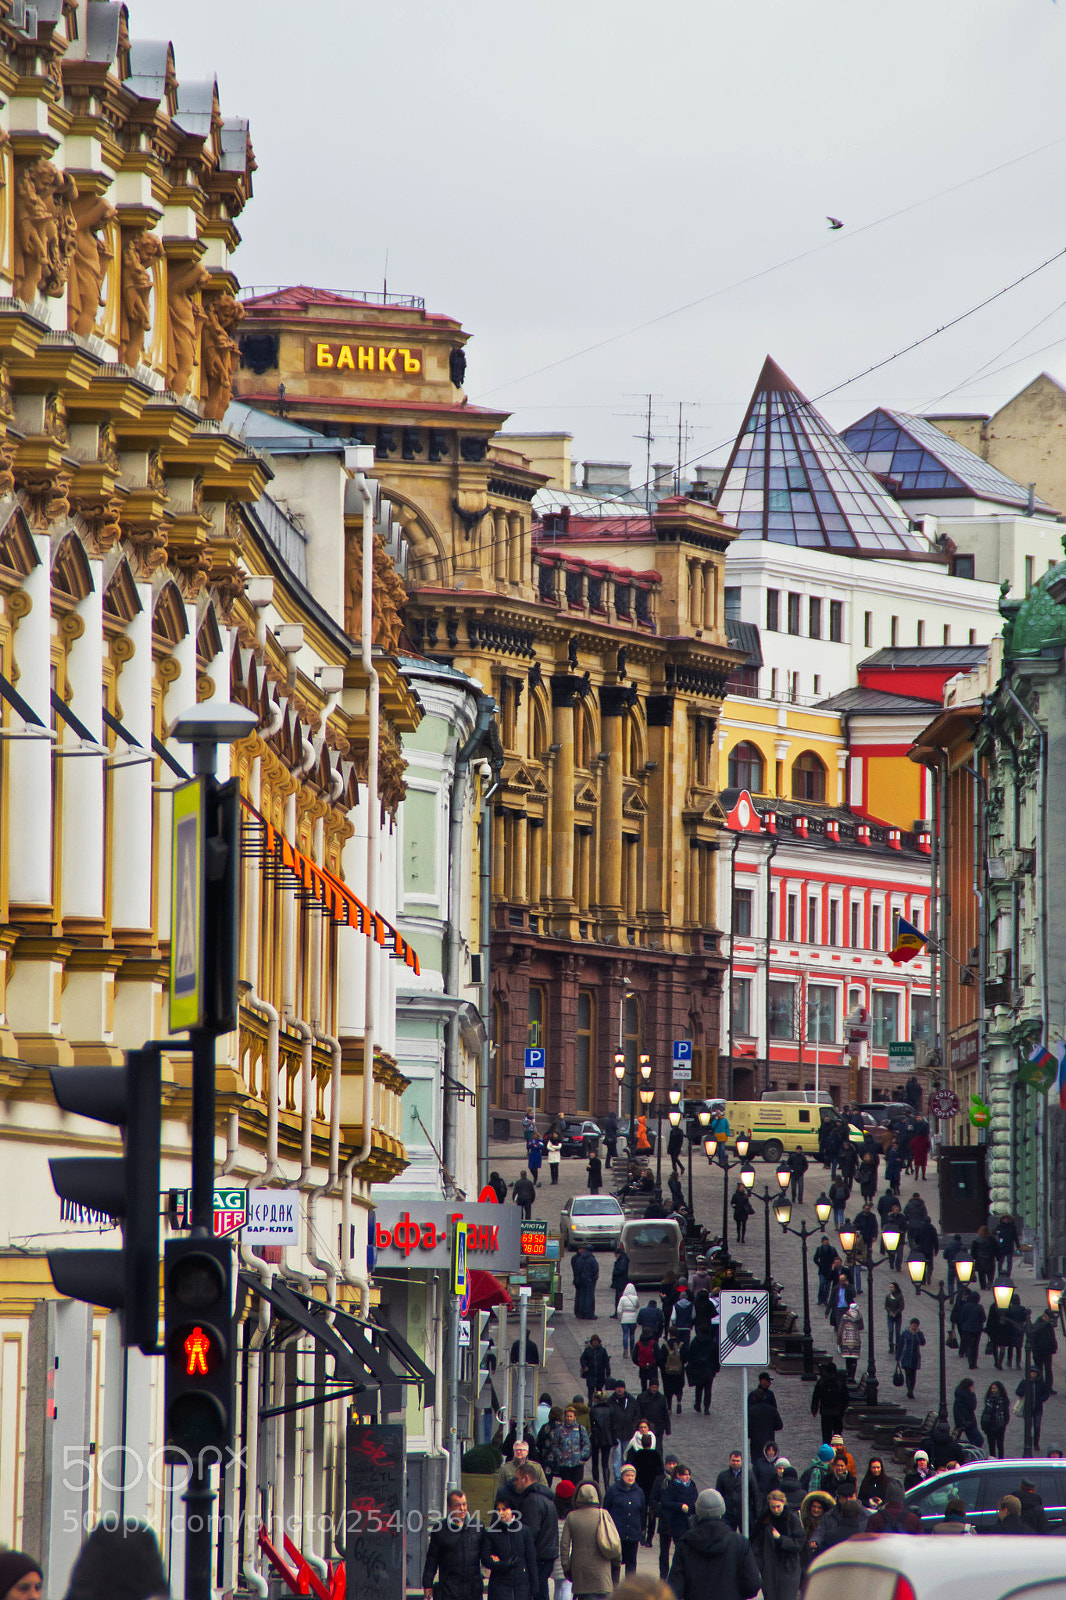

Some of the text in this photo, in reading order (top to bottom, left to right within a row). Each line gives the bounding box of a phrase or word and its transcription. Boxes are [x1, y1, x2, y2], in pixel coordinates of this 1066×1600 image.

[316, 343, 421, 373] БАНКЪ
[213, 1192, 241, 1208] AG
[731, 1295, 759, 1305] ЗОНА
